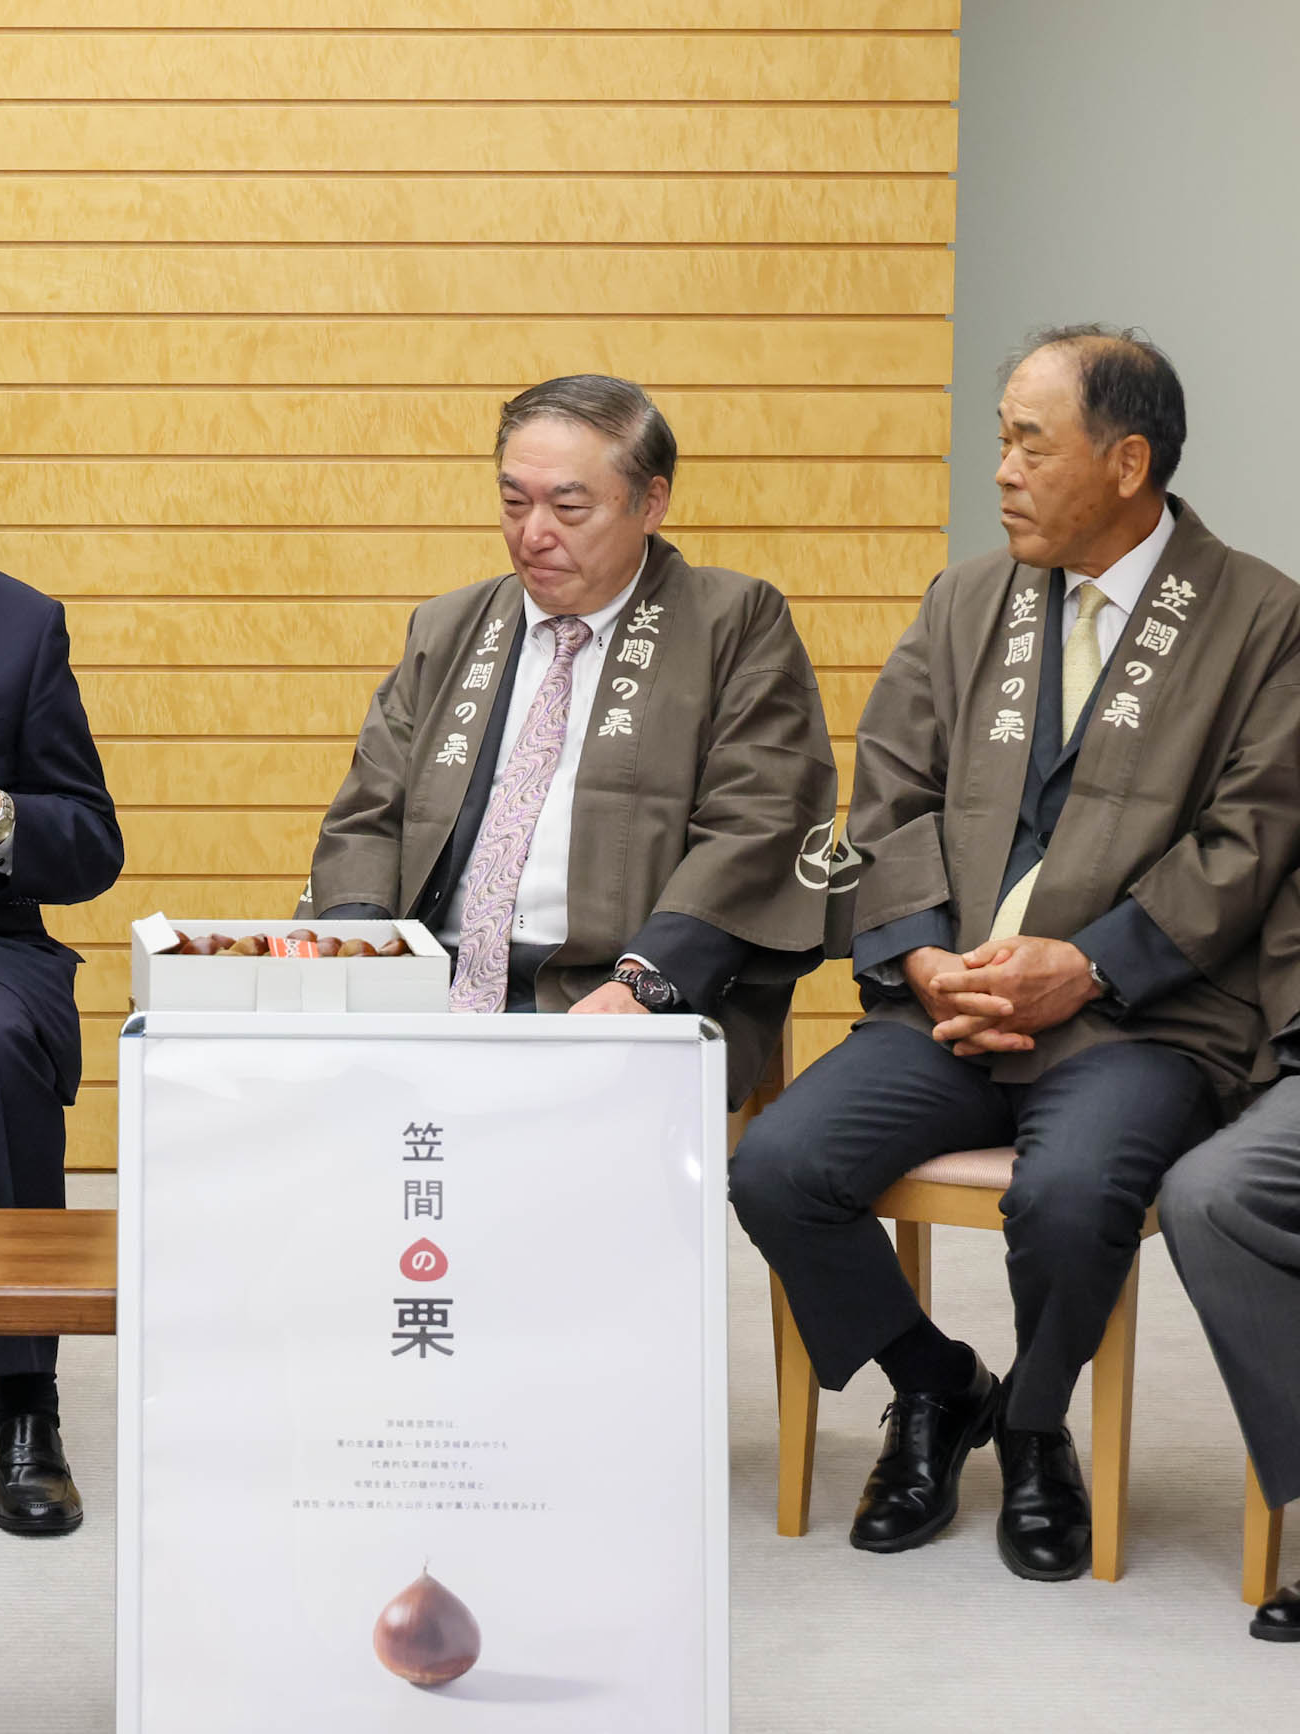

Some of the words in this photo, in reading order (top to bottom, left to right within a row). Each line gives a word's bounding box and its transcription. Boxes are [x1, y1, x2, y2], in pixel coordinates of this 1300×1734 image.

[435, 618, 505, 767] 笠間の栗
[597, 599, 665, 738] 笠間の栗
[989, 587, 1040, 744] 笠間の栗
[1101, 573, 1197, 729] 笠間の栗
[391, 1122, 454, 1359] 笠間の栗
